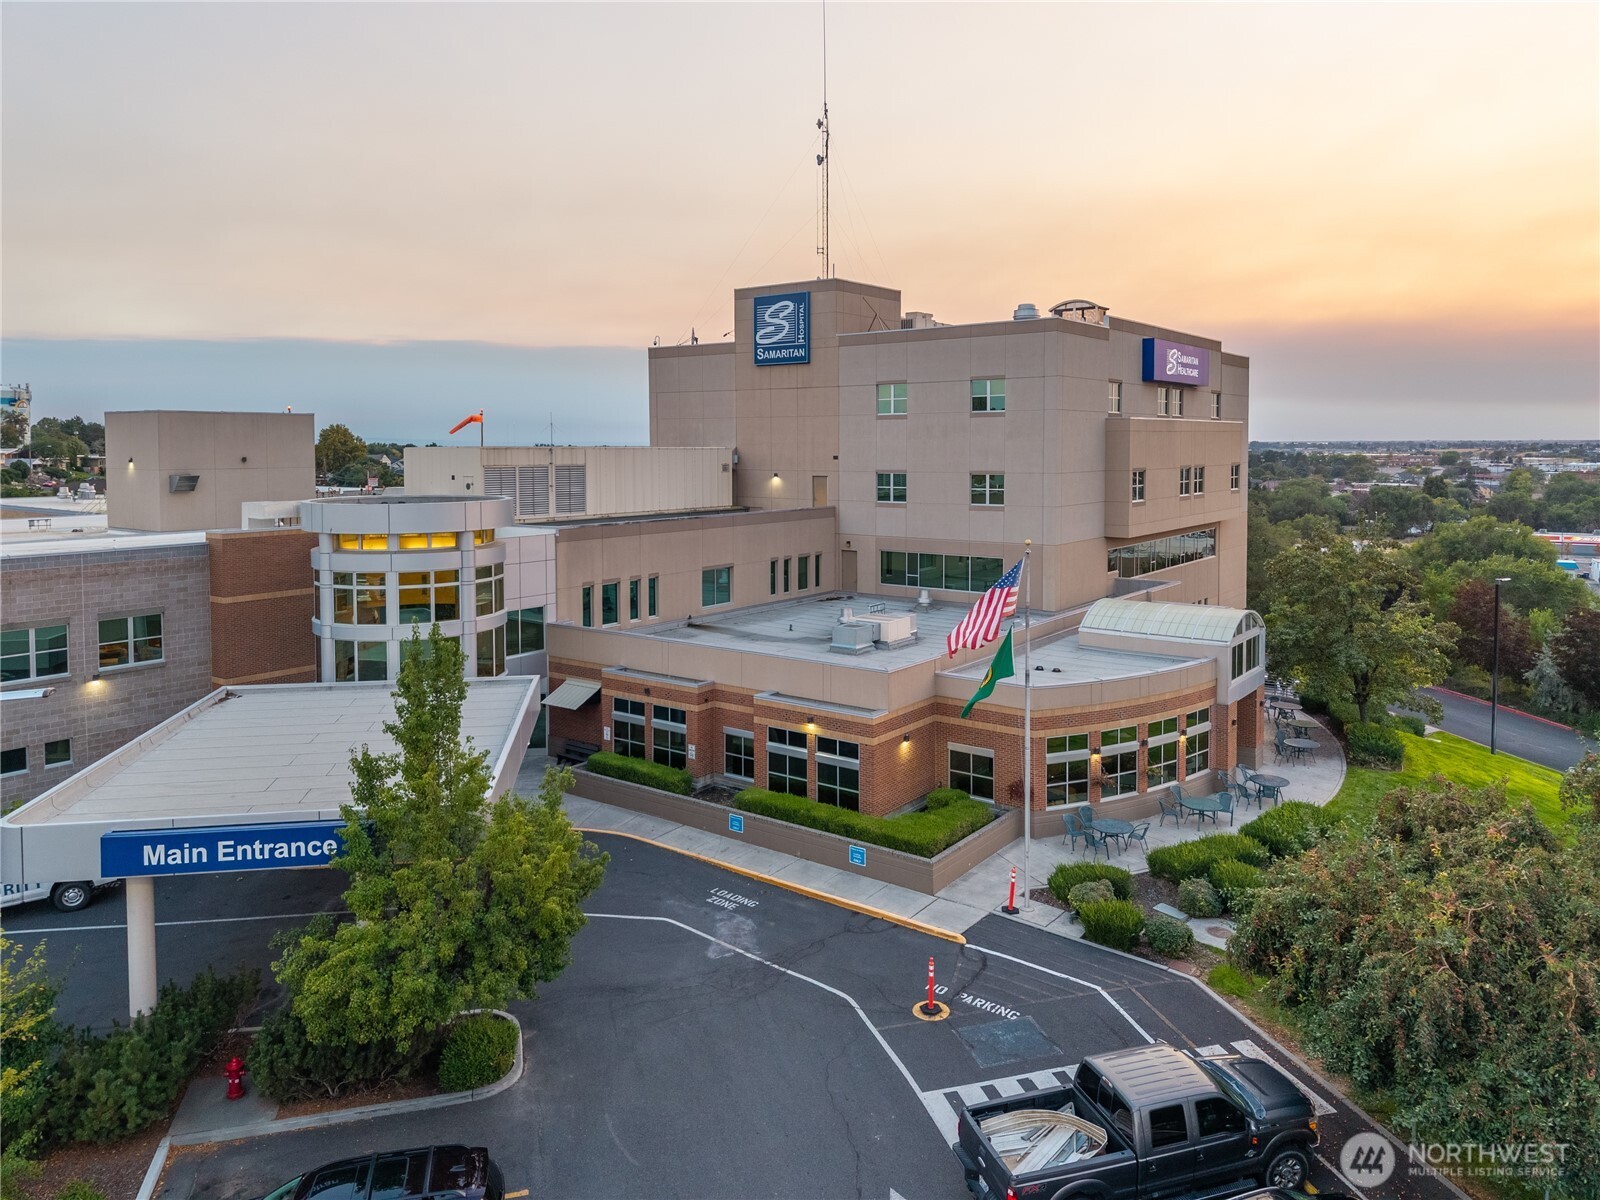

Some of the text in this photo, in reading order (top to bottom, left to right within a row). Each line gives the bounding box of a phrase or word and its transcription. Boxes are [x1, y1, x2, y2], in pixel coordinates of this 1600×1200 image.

[757, 348, 805, 360] SAMARITAN
[1177, 351, 1199, 366] SAMARITAN
[1177, 363, 1199, 378] HEALTHCARE
[143, 839, 338, 866] Main Entrance
[705, 895, 740, 911] ZONE
[710, 887, 760, 908] LOADING
[960, 992, 1021, 1020] PARKING
